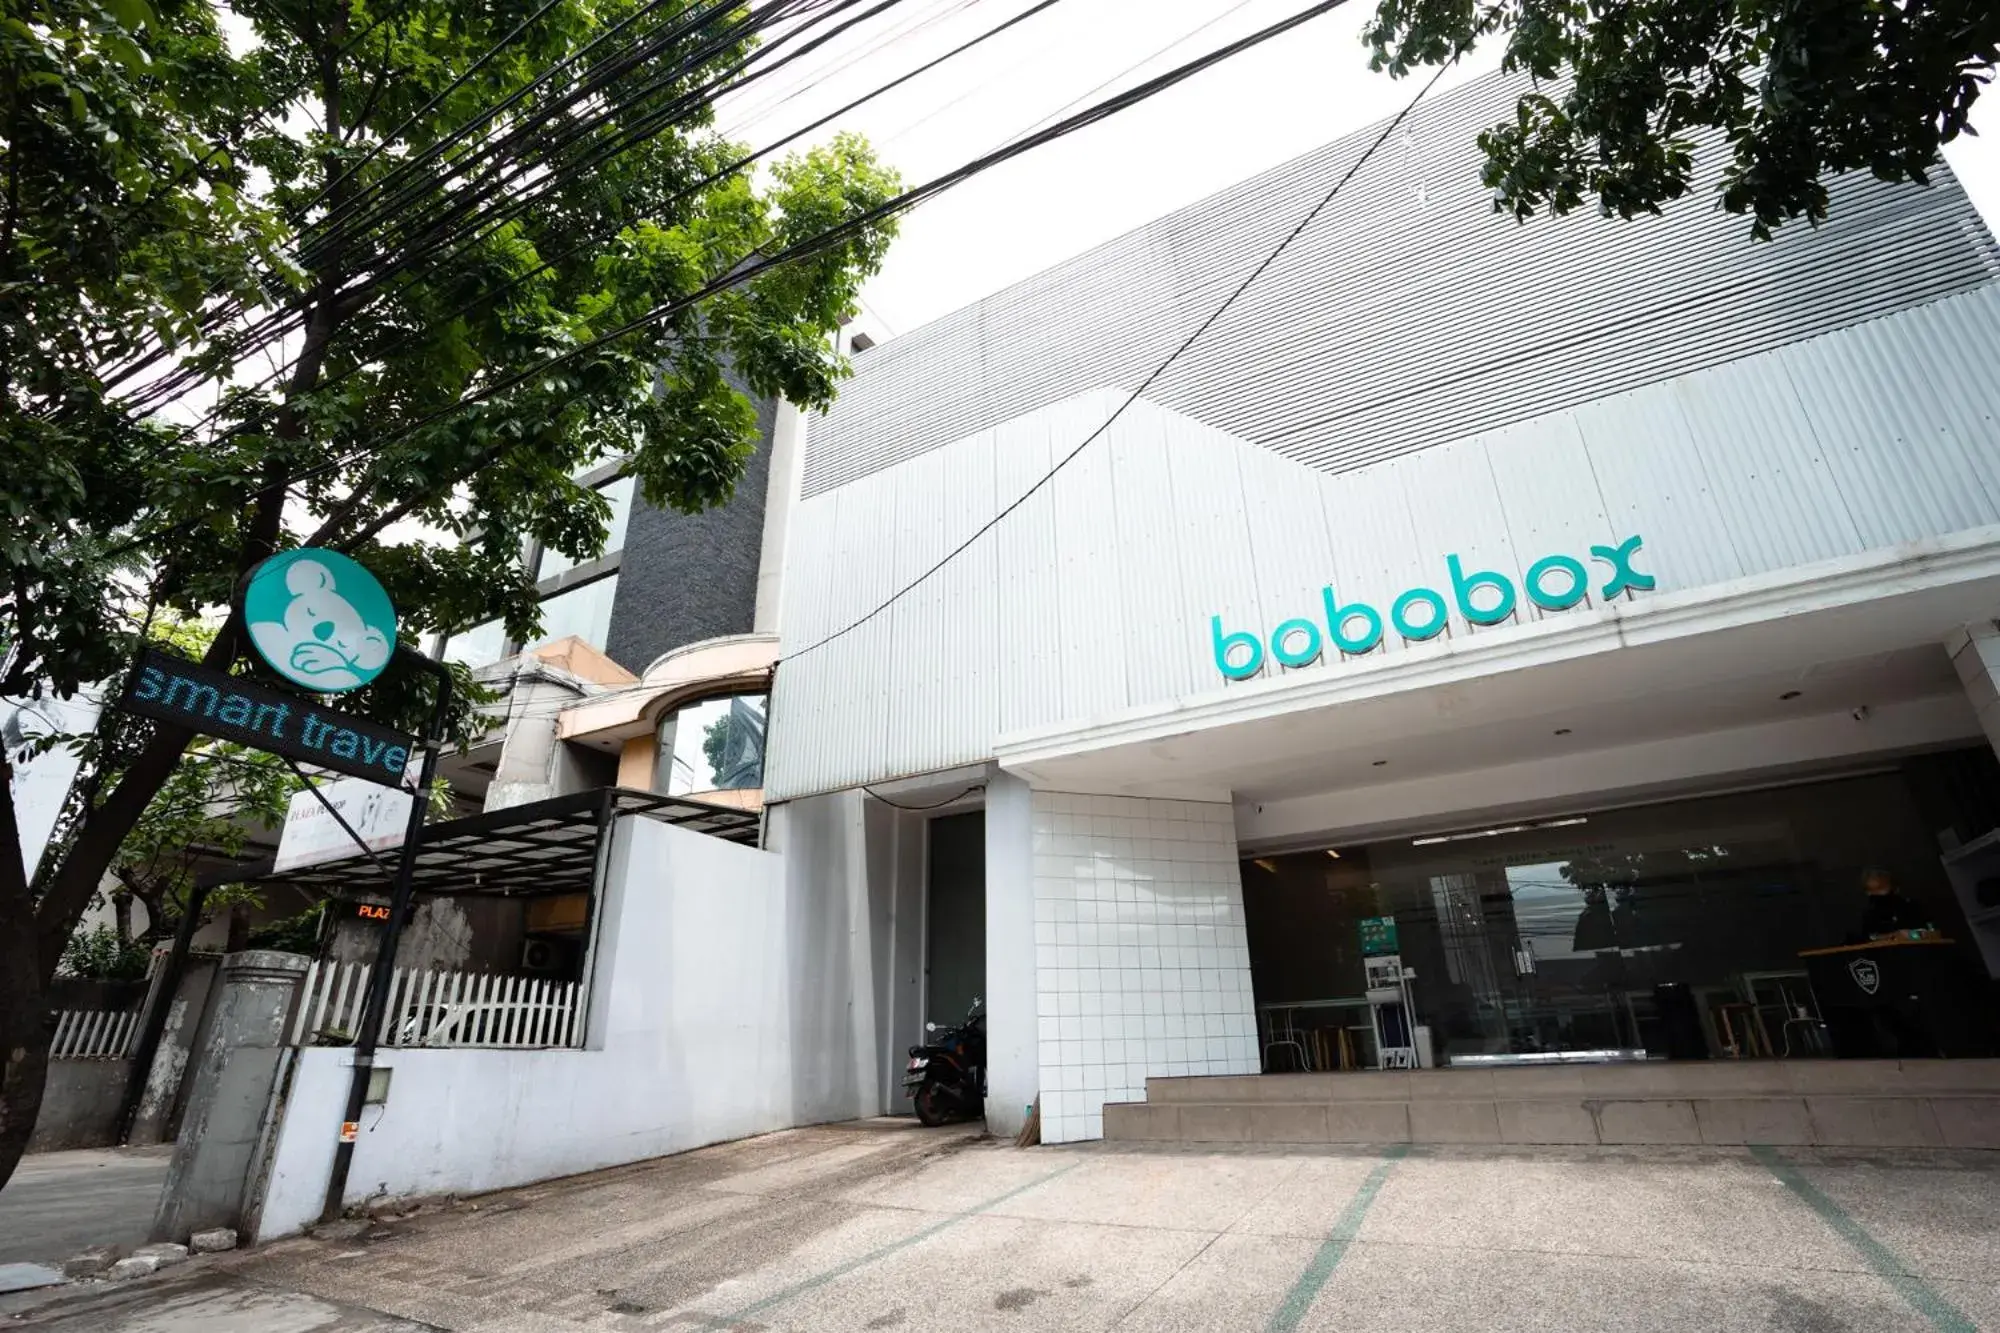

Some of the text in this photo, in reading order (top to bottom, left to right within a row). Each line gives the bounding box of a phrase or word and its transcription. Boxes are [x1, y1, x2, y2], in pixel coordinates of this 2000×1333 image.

[1211, 534, 1656, 681] bobobox
[135, 667, 406, 773] smart trave
